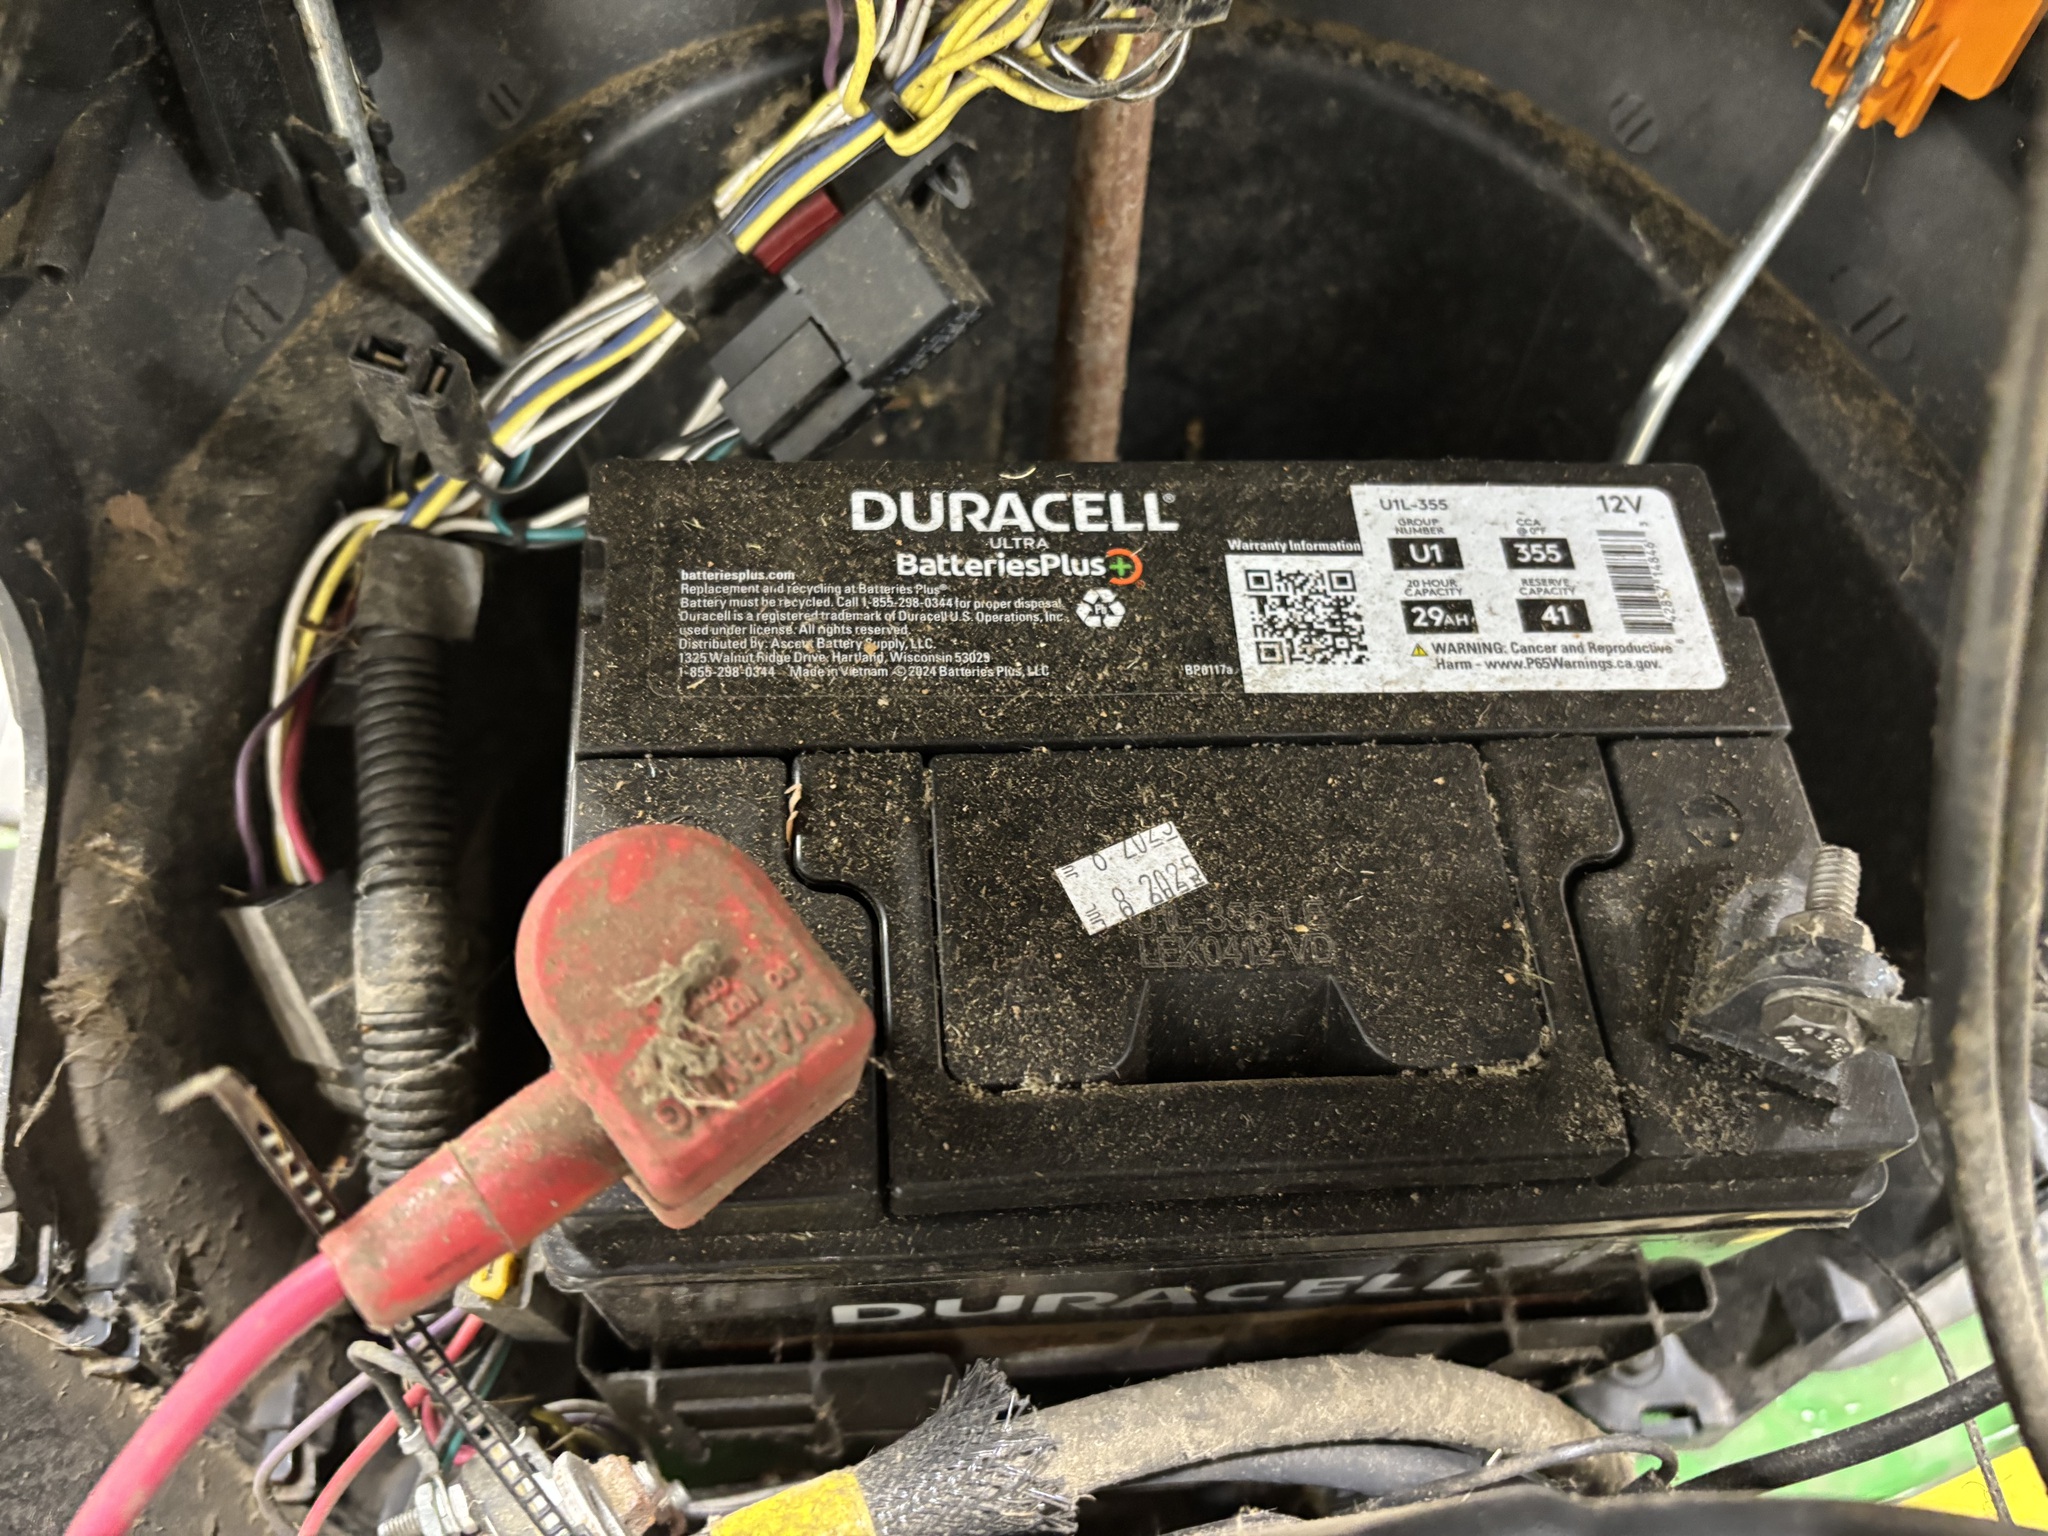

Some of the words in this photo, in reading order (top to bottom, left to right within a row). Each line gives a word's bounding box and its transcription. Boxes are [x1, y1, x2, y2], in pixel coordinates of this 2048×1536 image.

[1379, 499, 1449, 511] U1L-355
[1596, 495, 1642, 514] 12V
[1397, 518, 1440, 527] GROUP
[1516, 518, 1542, 527] CCA
[1394, 526, 1446, 535] NUMBER
[990, 537, 1050, 550] ULTRA
[1227, 539, 1288, 553] Warranty
[1289, 539, 1361, 552] Information
[1409, 543, 1443, 564] U1
[1513, 543, 1562, 564] 355
[681, 569, 796, 583] batteriesplus.com
[1521, 578, 1571, 587] RESERVE
[681, 583, 760, 596] Replacement
[762, 583, 785, 594] and
[787, 583, 842, 596] recycling
[845, 584, 857, 594] at
[858, 583, 913, 594] Batteries
[1406, 579, 1420, 588] 20
[1422, 579, 1458, 588] HOUR
[1403, 587, 1463, 597] CAPACITY
[1519, 587, 1576, 596] CAPACITY
[681, 597, 727, 609] Battery
[729, 598, 759, 607] must
[761, 596, 776, 607] be
[779, 597, 834, 609] recycled.
[836, 597, 859, 608] Call
[861, 597, 953, 608] 1-855-298-0344
[955, 597, 971, 608] for
[974, 600, 1011, 611] proper
[679, 610, 731, 621] Duracell
[733, 610, 744, 621] is
[746, 612, 754, 621] a
[756, 610, 818, 623] registered
[820, 610, 882, 621] trademark
[884, 610, 897, 621] of
[898, 610, 948, 622] Duracell
[949, 611, 974, 622] U.S.
[976, 611, 1043, 624] Operations,
[1541, 604, 1571, 626] 41
[679, 625, 709, 635] used
[711, 624, 748, 635] under
[799, 624, 816, 634] All
[818, 624, 853, 637] rights
[855, 625, 911, 636] reserved.
[679, 637, 748, 649] Distributed
[816, 637, 864, 650] Battery
[910, 638, 937, 649] LLC.
[1431, 642, 1508, 654] WARNING:
[1510, 641, 1557, 654] Cancer
[1561, 642, 1585, 654] and
[1587, 641, 1673, 656] Reproductive
[679, 652, 707, 663] 1325
[709, 652, 756, 663] Walnut
[757, 649, 791, 665] Ridge
[832, 651, 887, 664] Hartland,
[890, 651, 952, 663] Wisconsin
[954, 652, 991, 663] 53029
[1436, 658, 1473, 670] Harm
[1484, 657, 1662, 671] www.P65Warnings.ca.gov.
[679, 666, 775, 678] 1-855-298-0344
[789, 666, 825, 677] Made
[840, 666, 889, 677] Vietnam
[939, 665, 995, 677] Batteries
[996, 664, 1026, 678] Plus,
[1111, 887, 1135, 918] 8
[1138, 855, 1201, 905] 2025
[831, 1269, 1483, 1323] DURACELL
